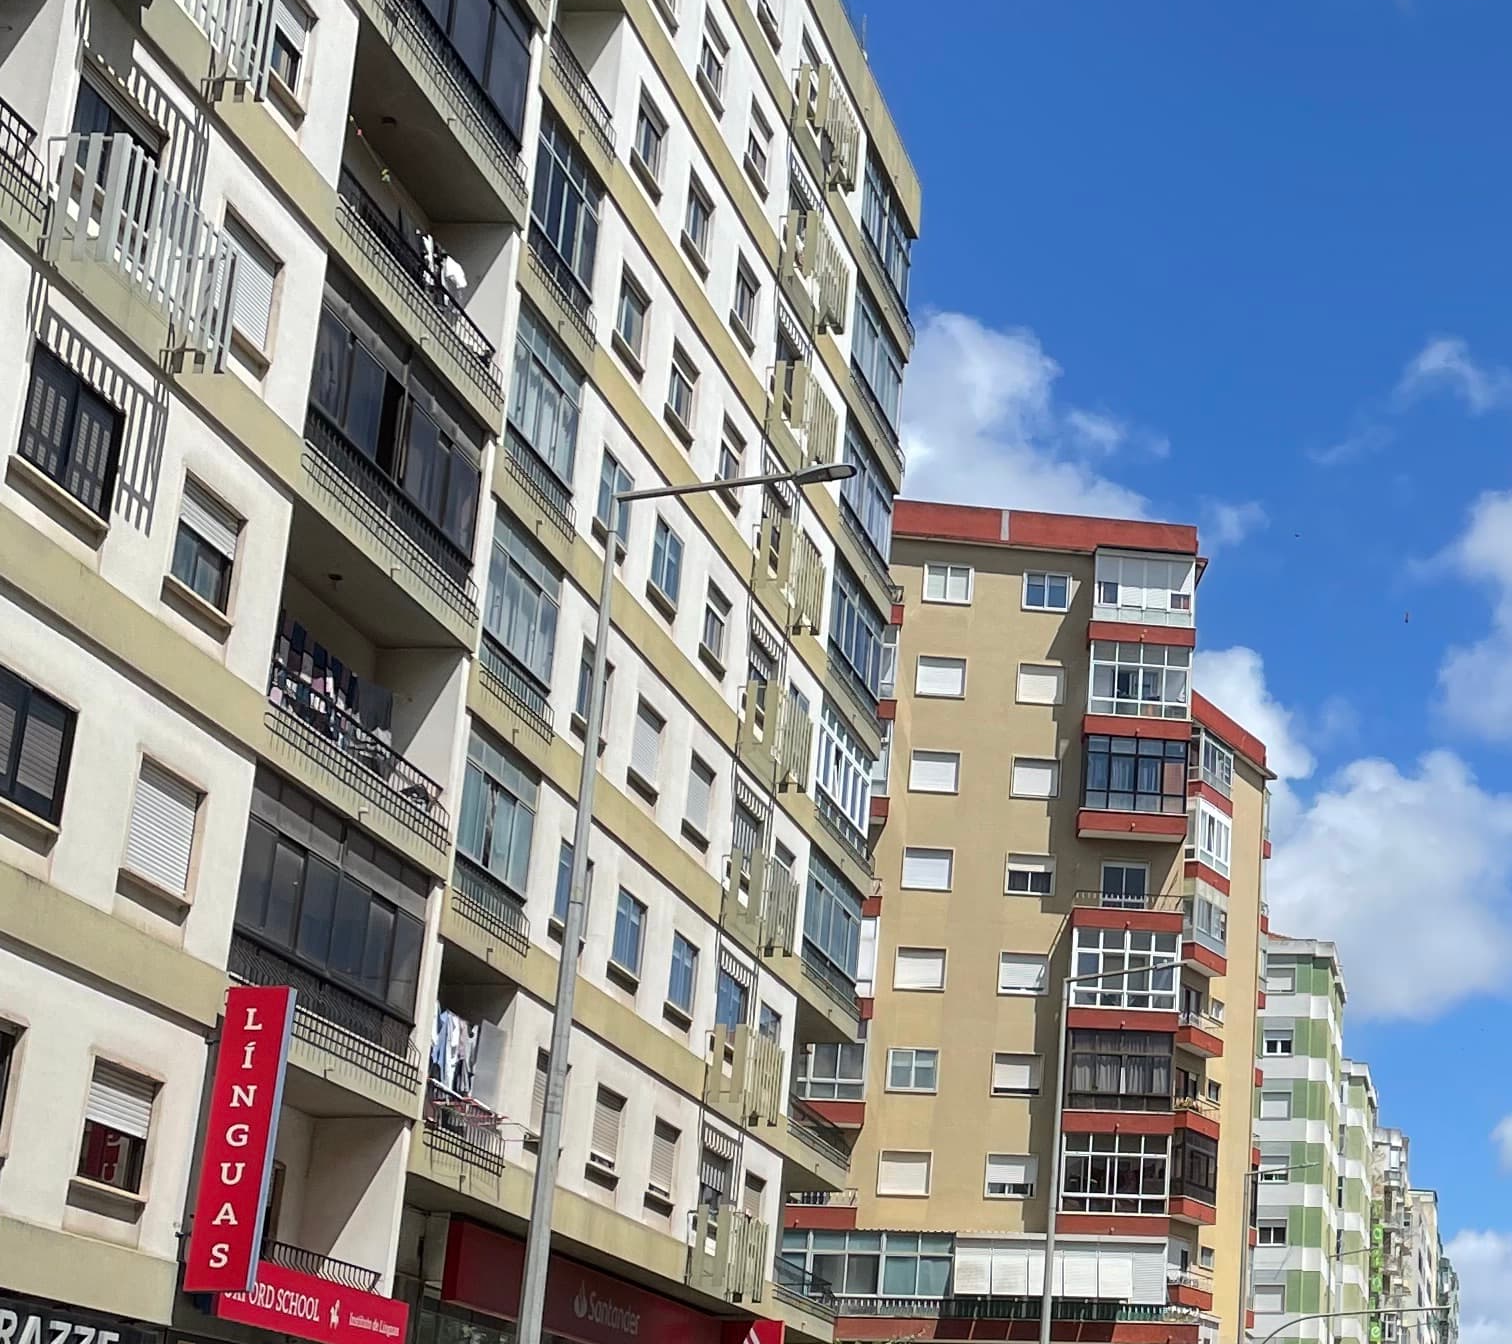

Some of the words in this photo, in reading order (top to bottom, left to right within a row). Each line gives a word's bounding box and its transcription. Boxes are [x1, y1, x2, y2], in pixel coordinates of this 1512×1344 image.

[209, 1007, 263, 1268] LÍNGUAS
[275, 1288, 320, 1322] SCHOOL
[588, 1291, 641, 1336] Santander
